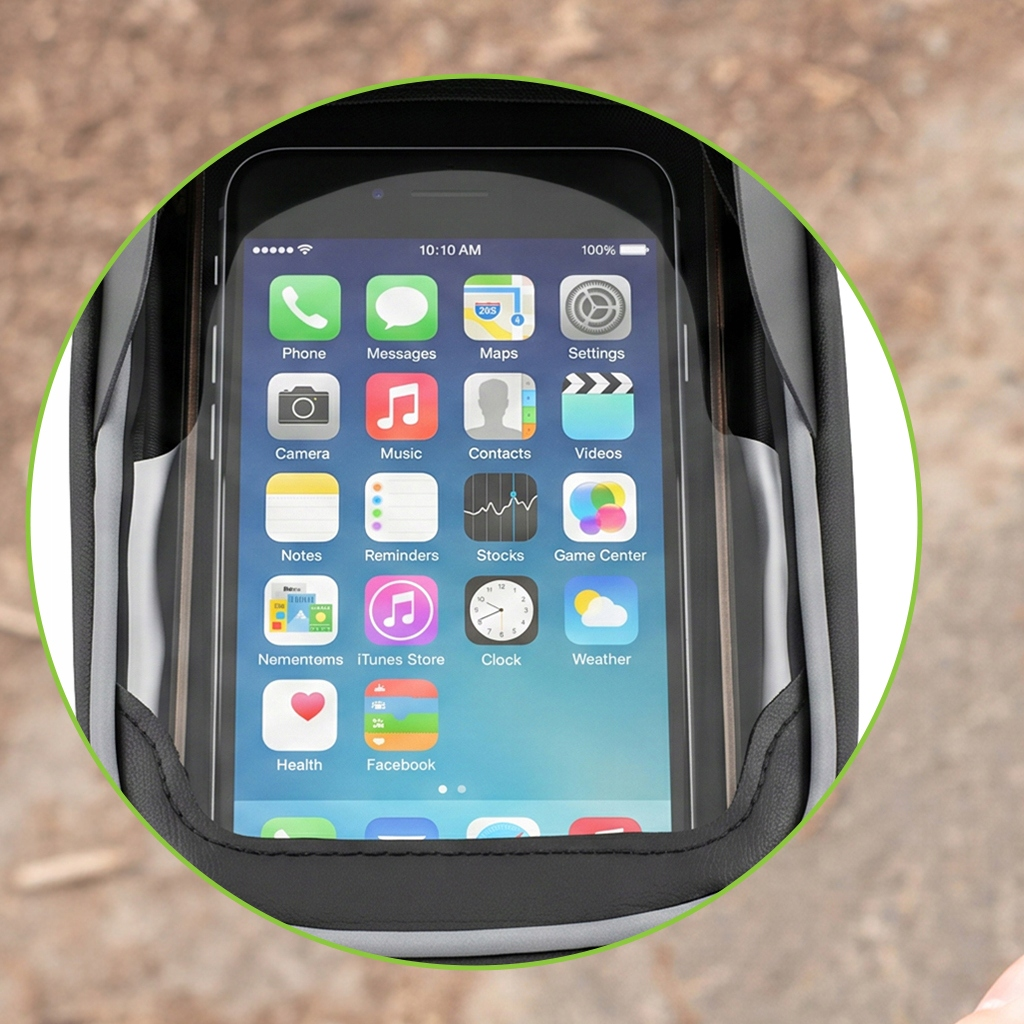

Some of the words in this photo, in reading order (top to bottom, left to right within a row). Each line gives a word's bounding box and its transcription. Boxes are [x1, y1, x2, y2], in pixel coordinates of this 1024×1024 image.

[419, 244, 455, 256] 10:10
[457, 244, 482, 256] AM
[581, 244, 617, 257] 100%
[282, 347, 327, 360] Phone
[366, 347, 437, 363] Messages
[479, 347, 519, 363] Maps
[568, 346, 626, 363] Settings
[275, 447, 330, 460] Camera
[380, 447, 423, 460] Music
[468, 447, 532, 460] Contacts
[574, 447, 623, 460] Videos
[281, 549, 323, 562] Notes
[364, 549, 440, 562] Reminders
[476, 549, 525, 562] Stocks
[554, 549, 596, 562] Game
[599, 549, 647, 562] Center
[357, 652, 403, 666] iTunes
[407, 652, 446, 666] Store
[481, 652, 522, 666] Clock
[571, 652, 632, 666] Weather
[276, 758, 323, 772] Health
[367, 758, 436, 772] Facebook
